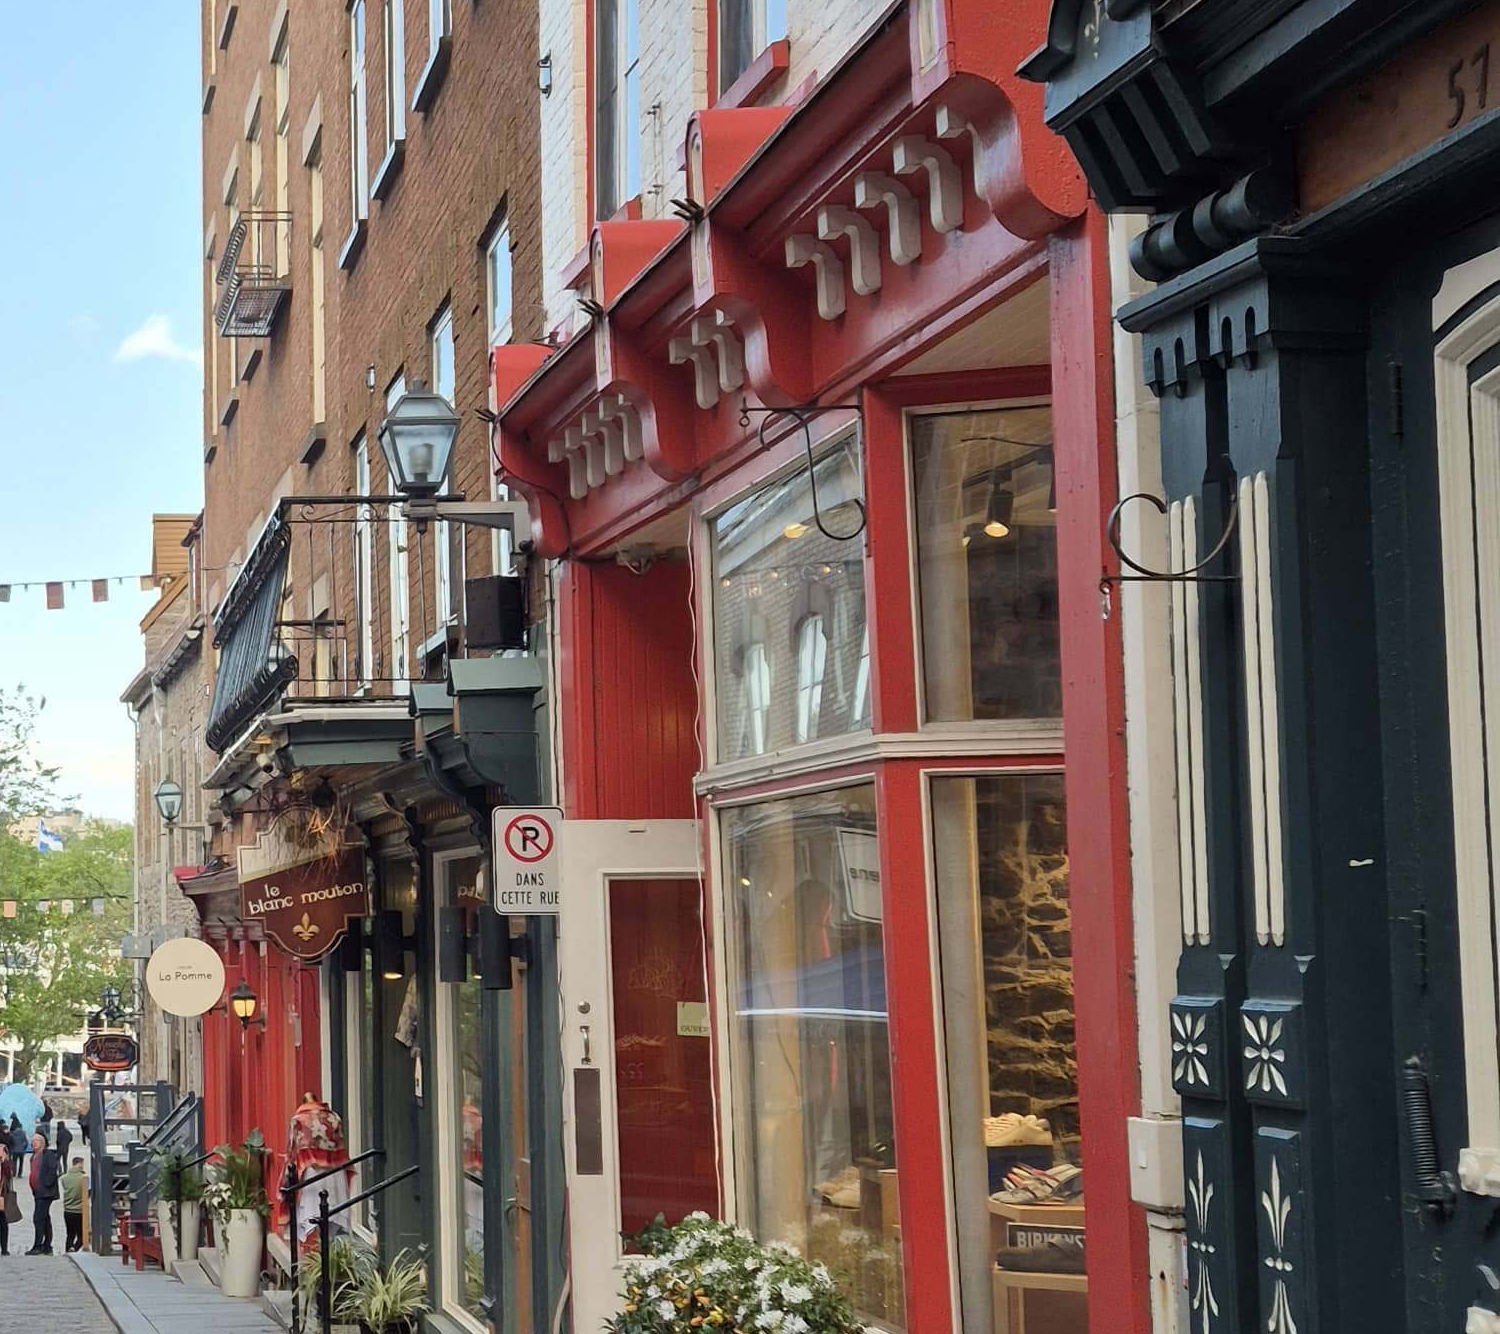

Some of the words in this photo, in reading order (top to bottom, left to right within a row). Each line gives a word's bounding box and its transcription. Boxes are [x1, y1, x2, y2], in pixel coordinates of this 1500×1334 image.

[516, 872, 545, 886] DANS
[263, 883, 281, 898] le
[248, 895, 295, 915] blanc
[300, 882, 364, 904] mouton
[501, 891, 533, 905] CETTE
[540, 891, 560, 905] RUE
[159, 970, 172, 982] La
[174, 970, 213, 982] Pomme
